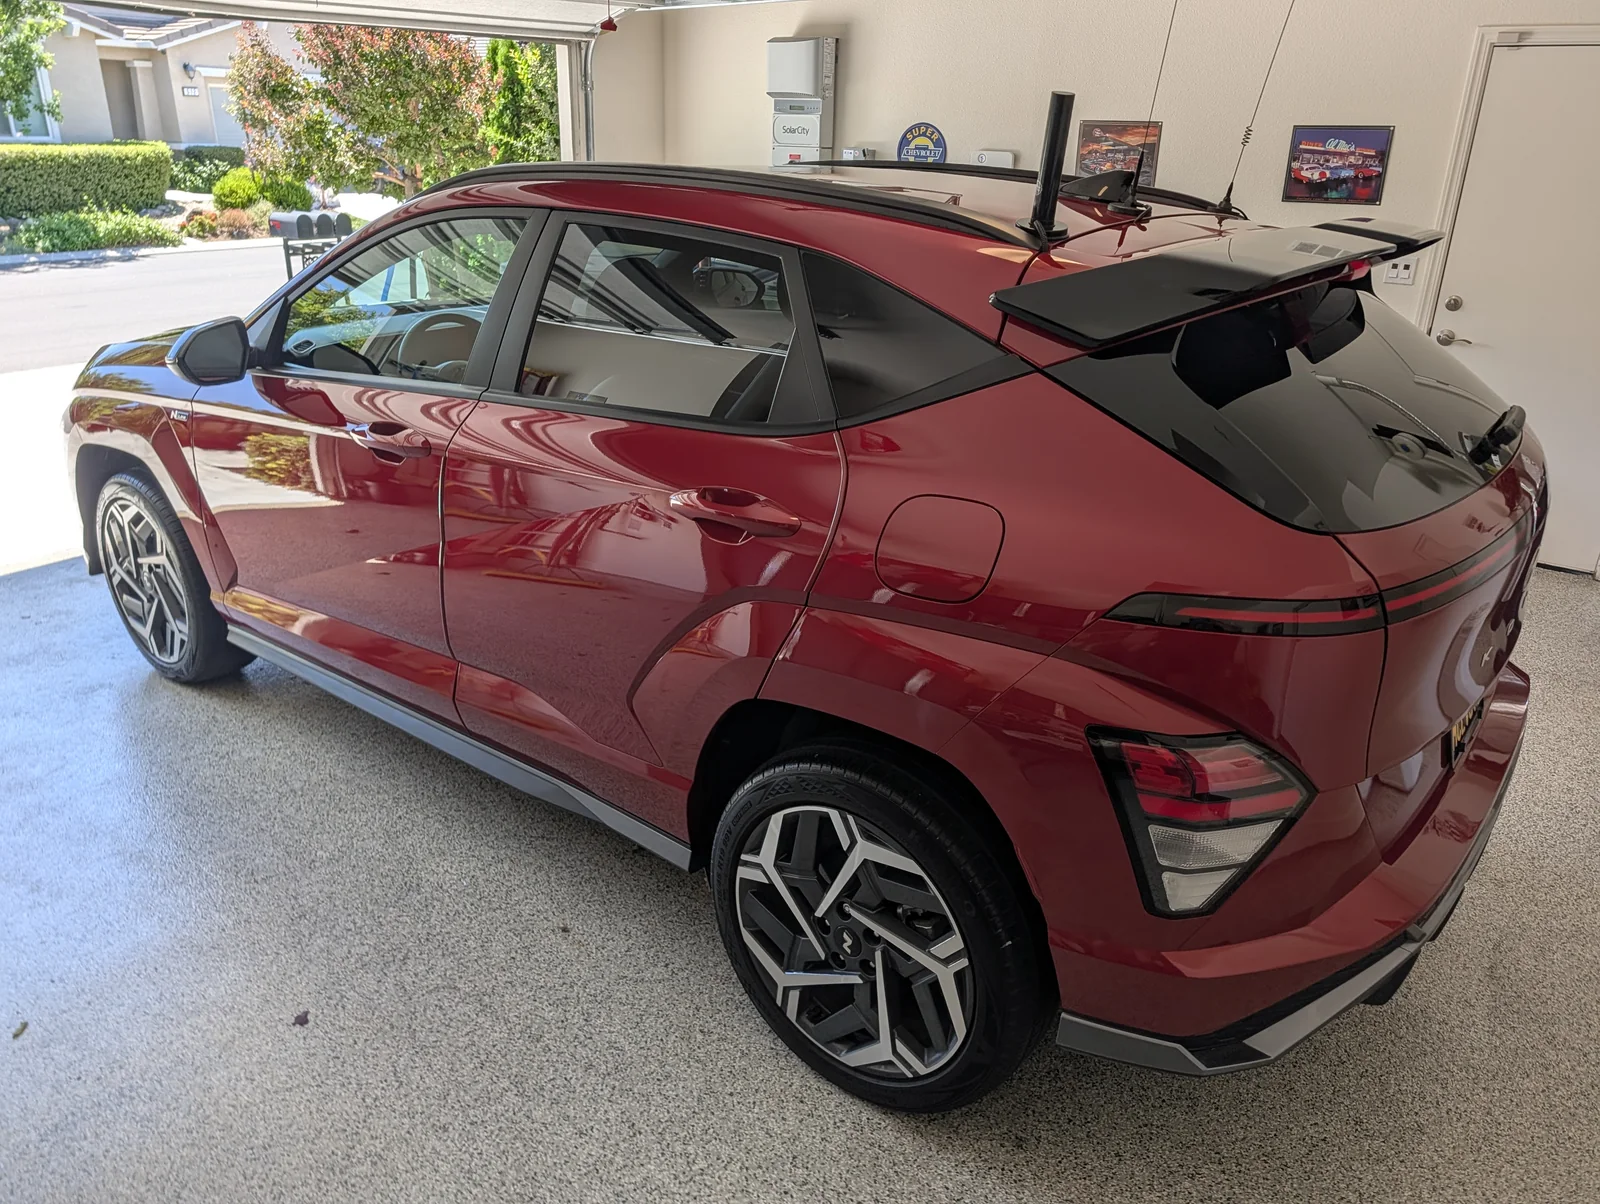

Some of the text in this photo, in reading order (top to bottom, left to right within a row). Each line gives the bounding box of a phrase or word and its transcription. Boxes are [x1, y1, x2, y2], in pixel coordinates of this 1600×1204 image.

[782, 125, 810, 136] SolarCity
[906, 126, 939, 142] SUPER
[904, 149, 940, 157] CHEVROLET
